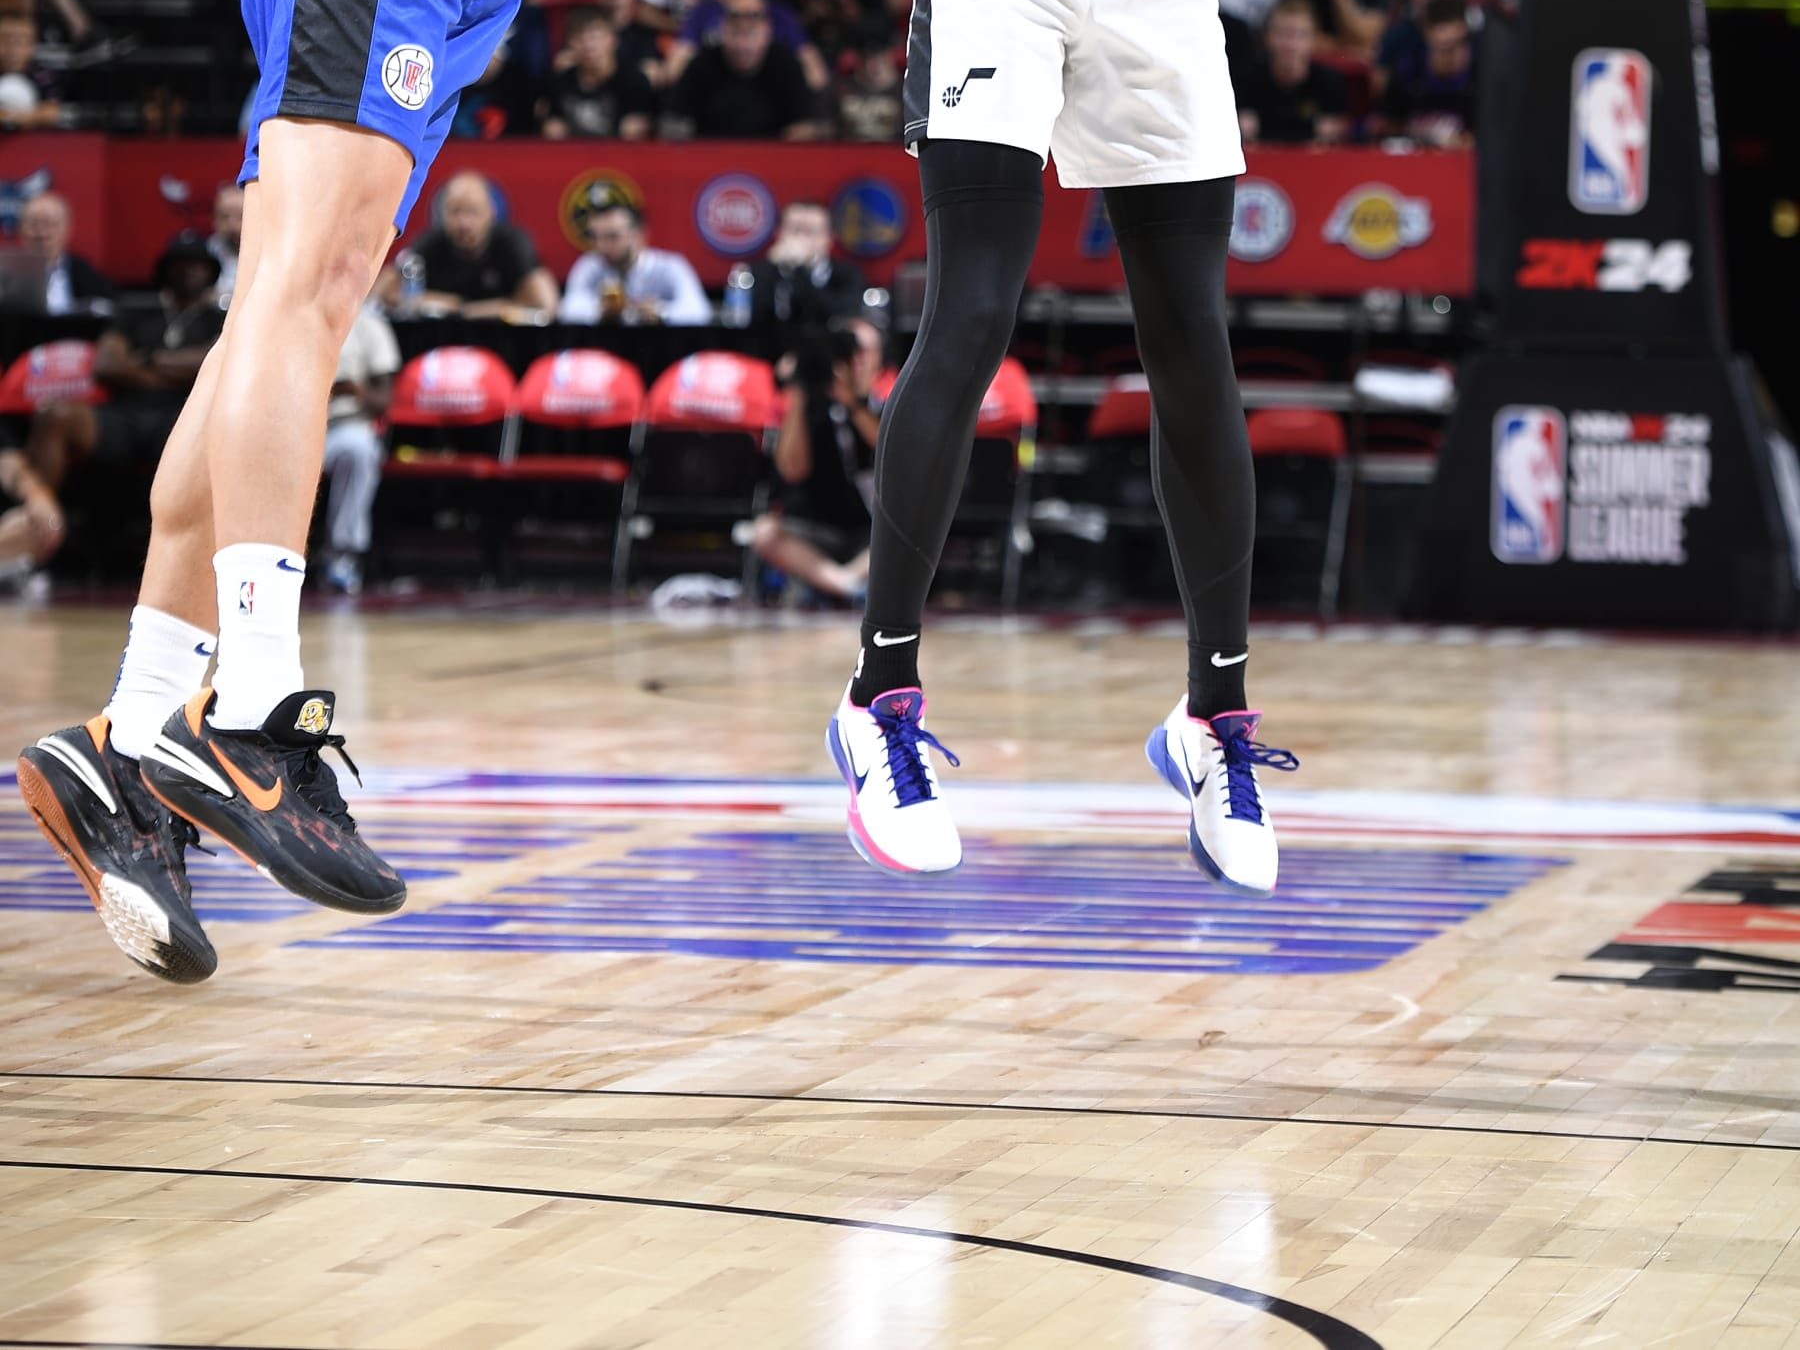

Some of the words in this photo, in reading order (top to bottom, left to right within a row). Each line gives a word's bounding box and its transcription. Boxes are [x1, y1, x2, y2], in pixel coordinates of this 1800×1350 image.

[1515, 237, 1693, 293] 2K24
[1569, 443, 1712, 508] SUMMER
[1568, 505, 1688, 565] LEAGUE
